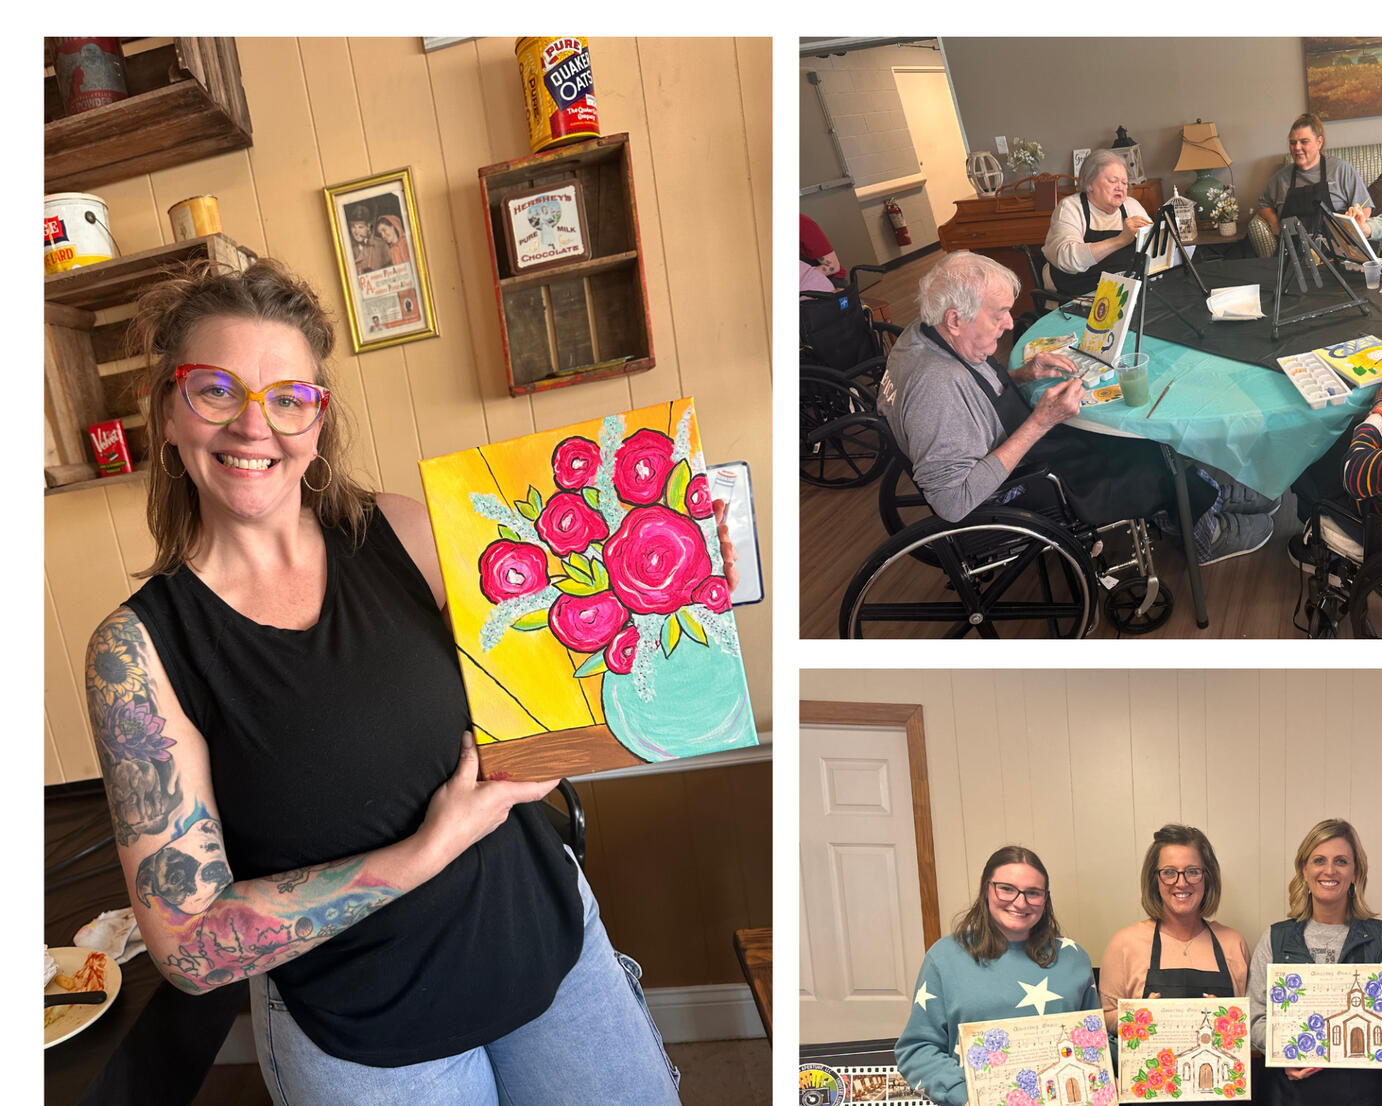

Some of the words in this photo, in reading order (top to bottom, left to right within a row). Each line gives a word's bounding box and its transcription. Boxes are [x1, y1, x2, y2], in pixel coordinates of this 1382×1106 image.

[545, 39, 581, 58] PURE
[550, 52, 590, 87] QUAKER
[560, 70, 593, 101] OATS
[513, 193, 572, 216] HERSHEY'S
[519, 231, 538, 246] PURE
[521, 245, 579, 263] CHOCOLATE
